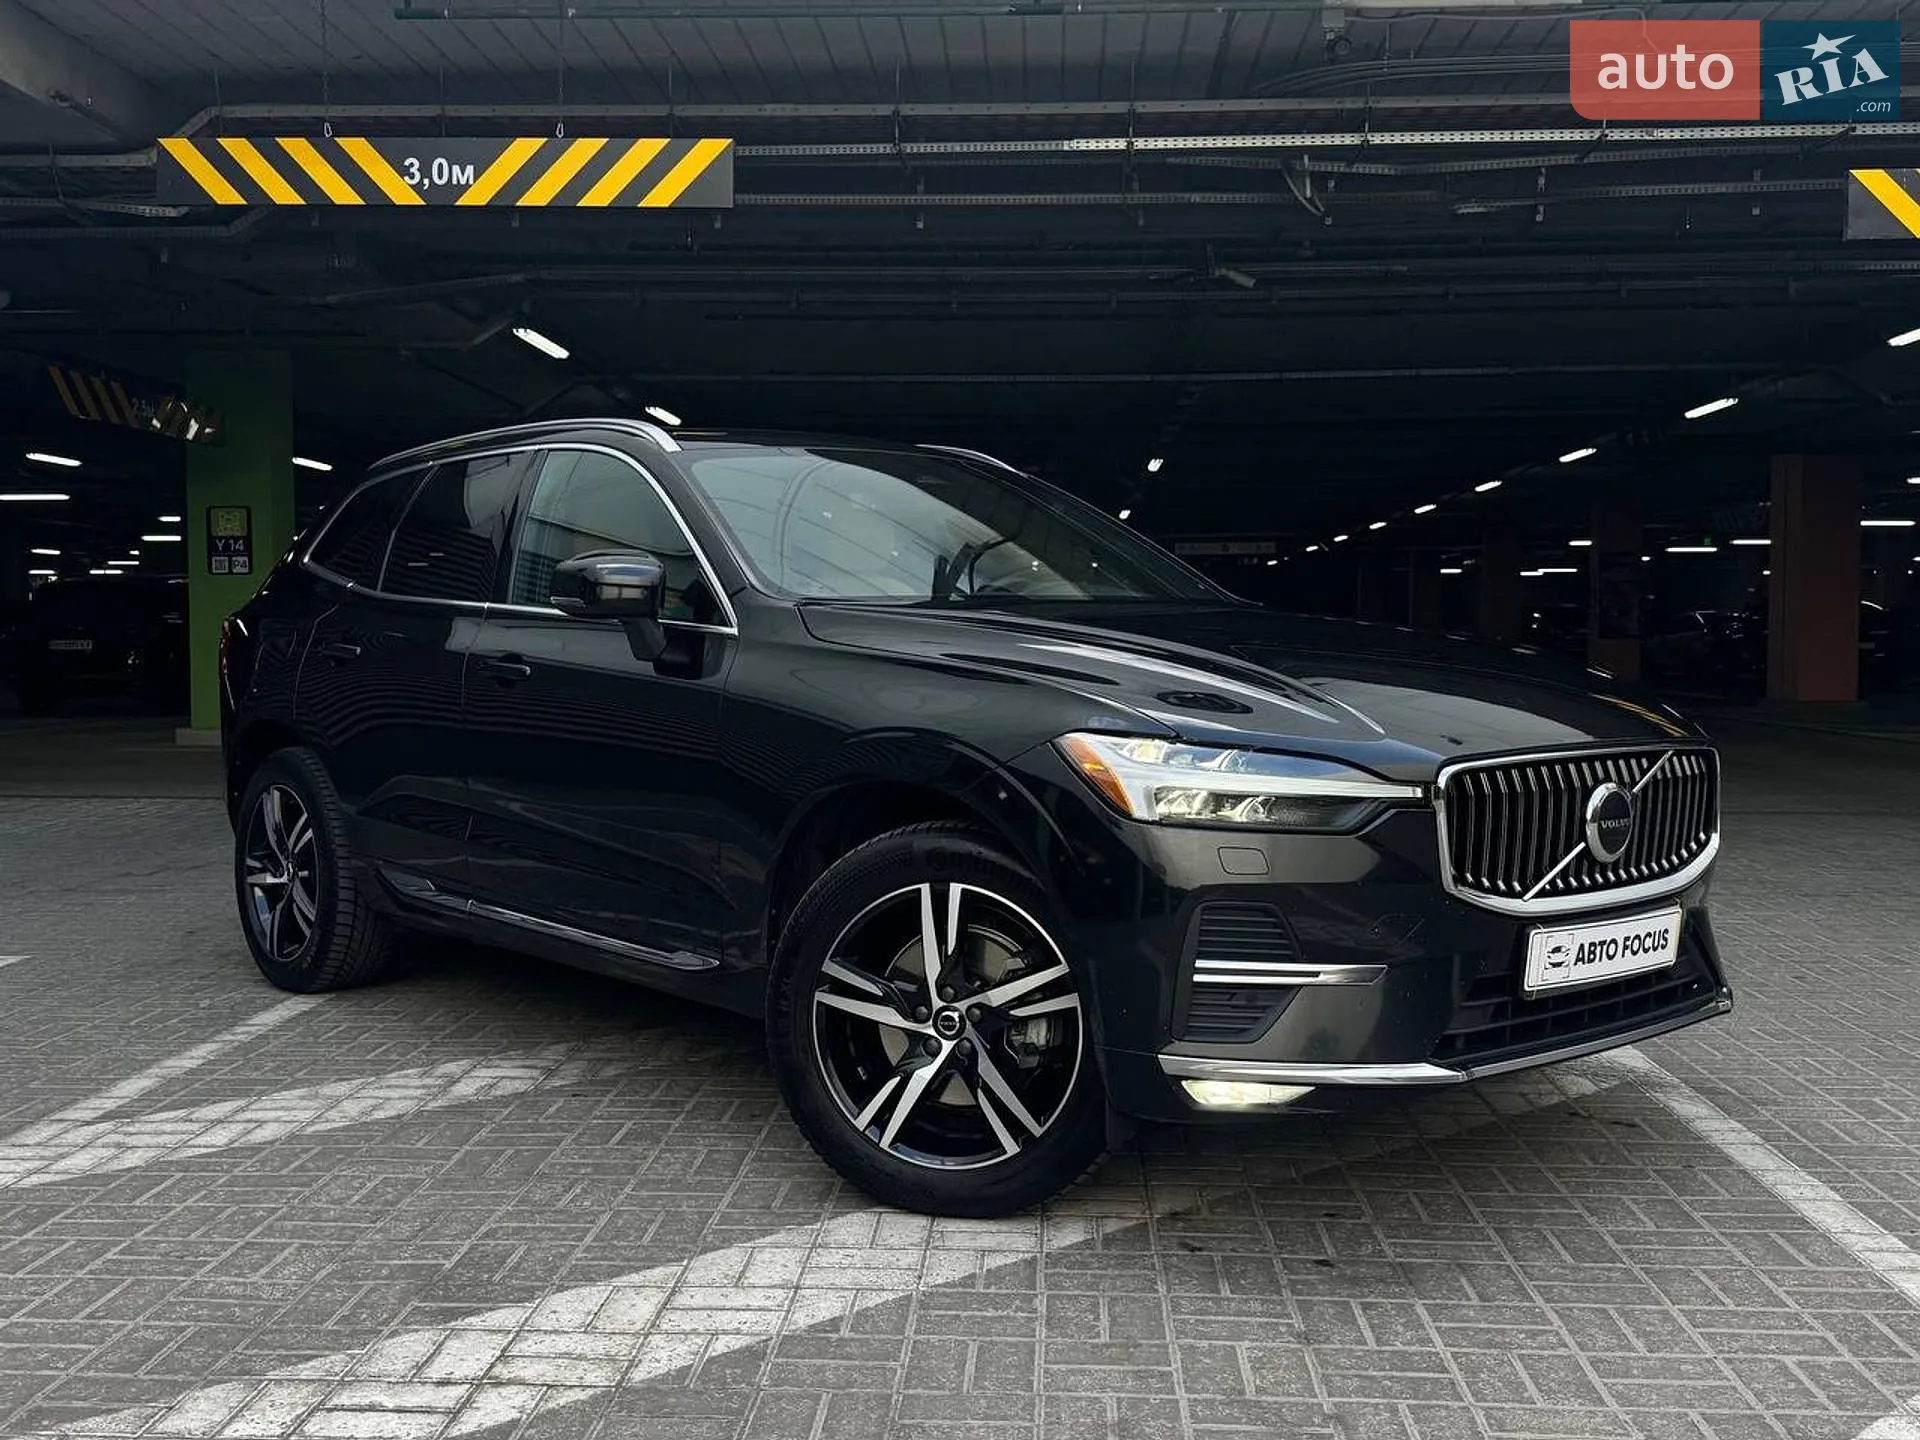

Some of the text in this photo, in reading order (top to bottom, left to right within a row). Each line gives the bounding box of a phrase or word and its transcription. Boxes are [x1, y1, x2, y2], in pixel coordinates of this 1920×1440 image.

[403, 157, 474, 190] 3,0м
[215, 539, 244, 551] Y 14
[1573, 928, 1669, 966] АВТО FOCUS
